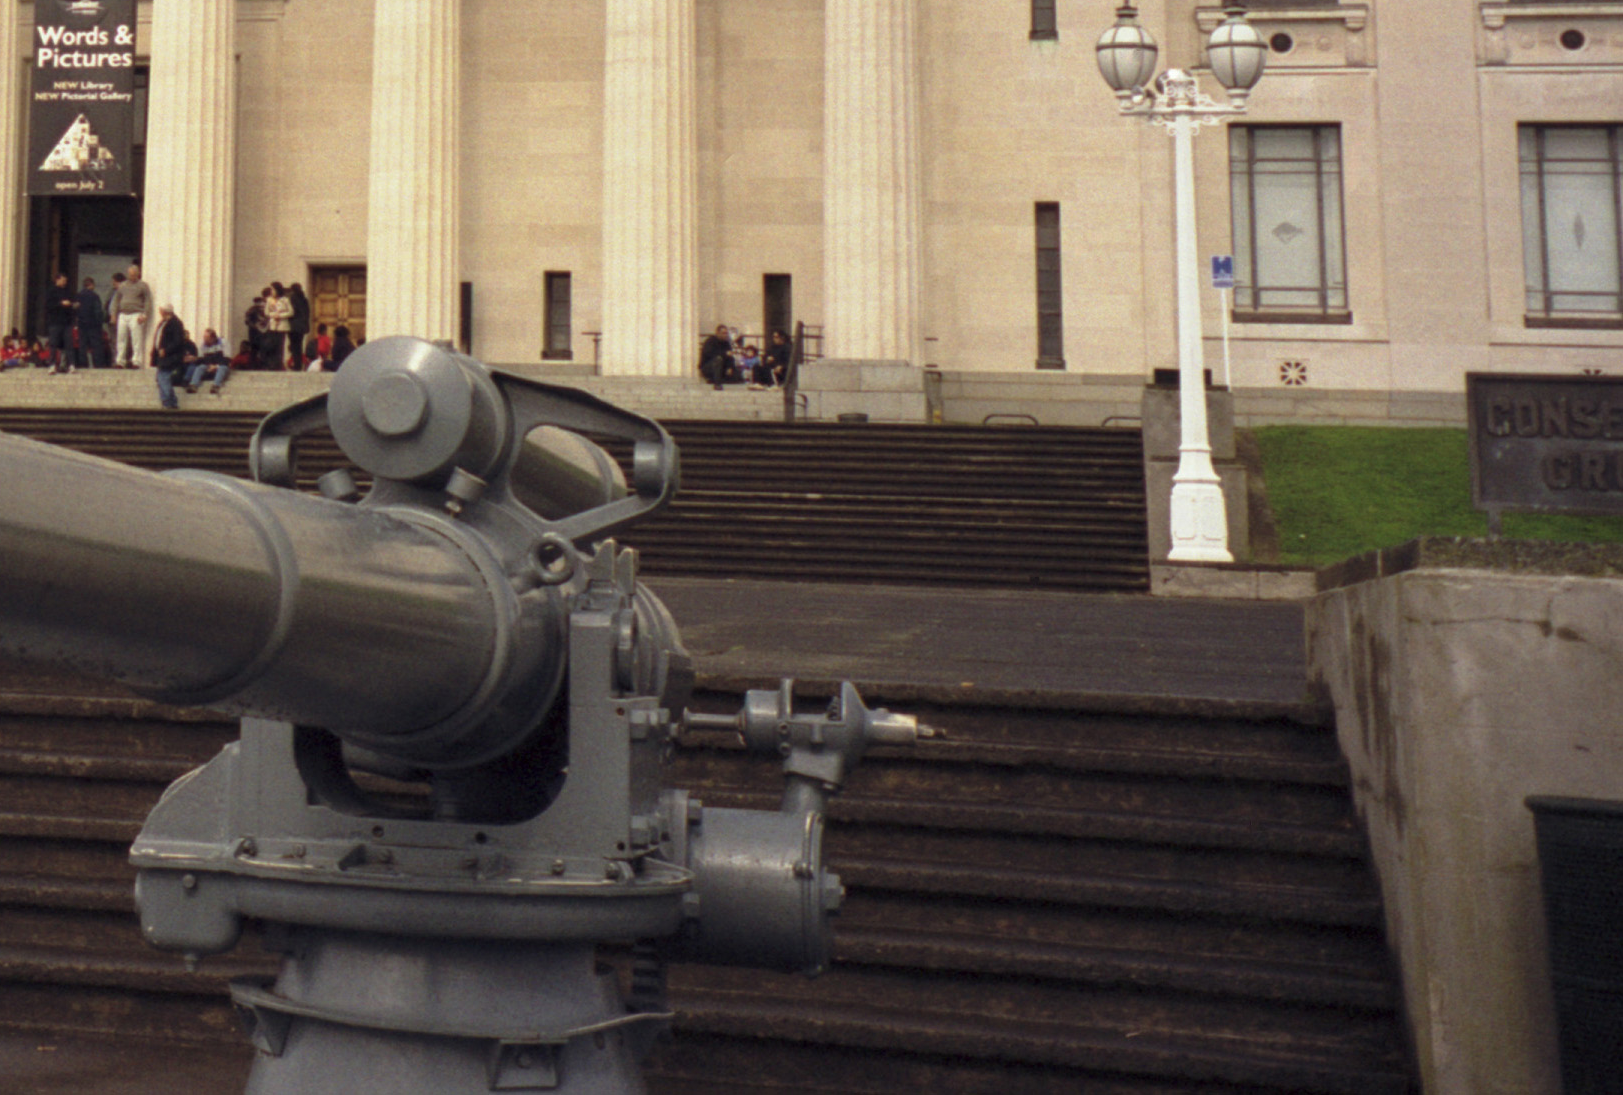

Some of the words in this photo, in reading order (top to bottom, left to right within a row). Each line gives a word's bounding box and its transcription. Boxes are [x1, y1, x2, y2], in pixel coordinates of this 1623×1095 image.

[37, 26, 108, 45] Words
[114, 24, 133, 45] &
[38, 48, 132, 68] Pictures
[53, 81, 78, 89] NEW
[80, 81, 114, 91] Library
[35, 92, 58, 100] NEW
[61, 92, 97, 100] Pictorial
[99, 92, 132, 102] Gallery
